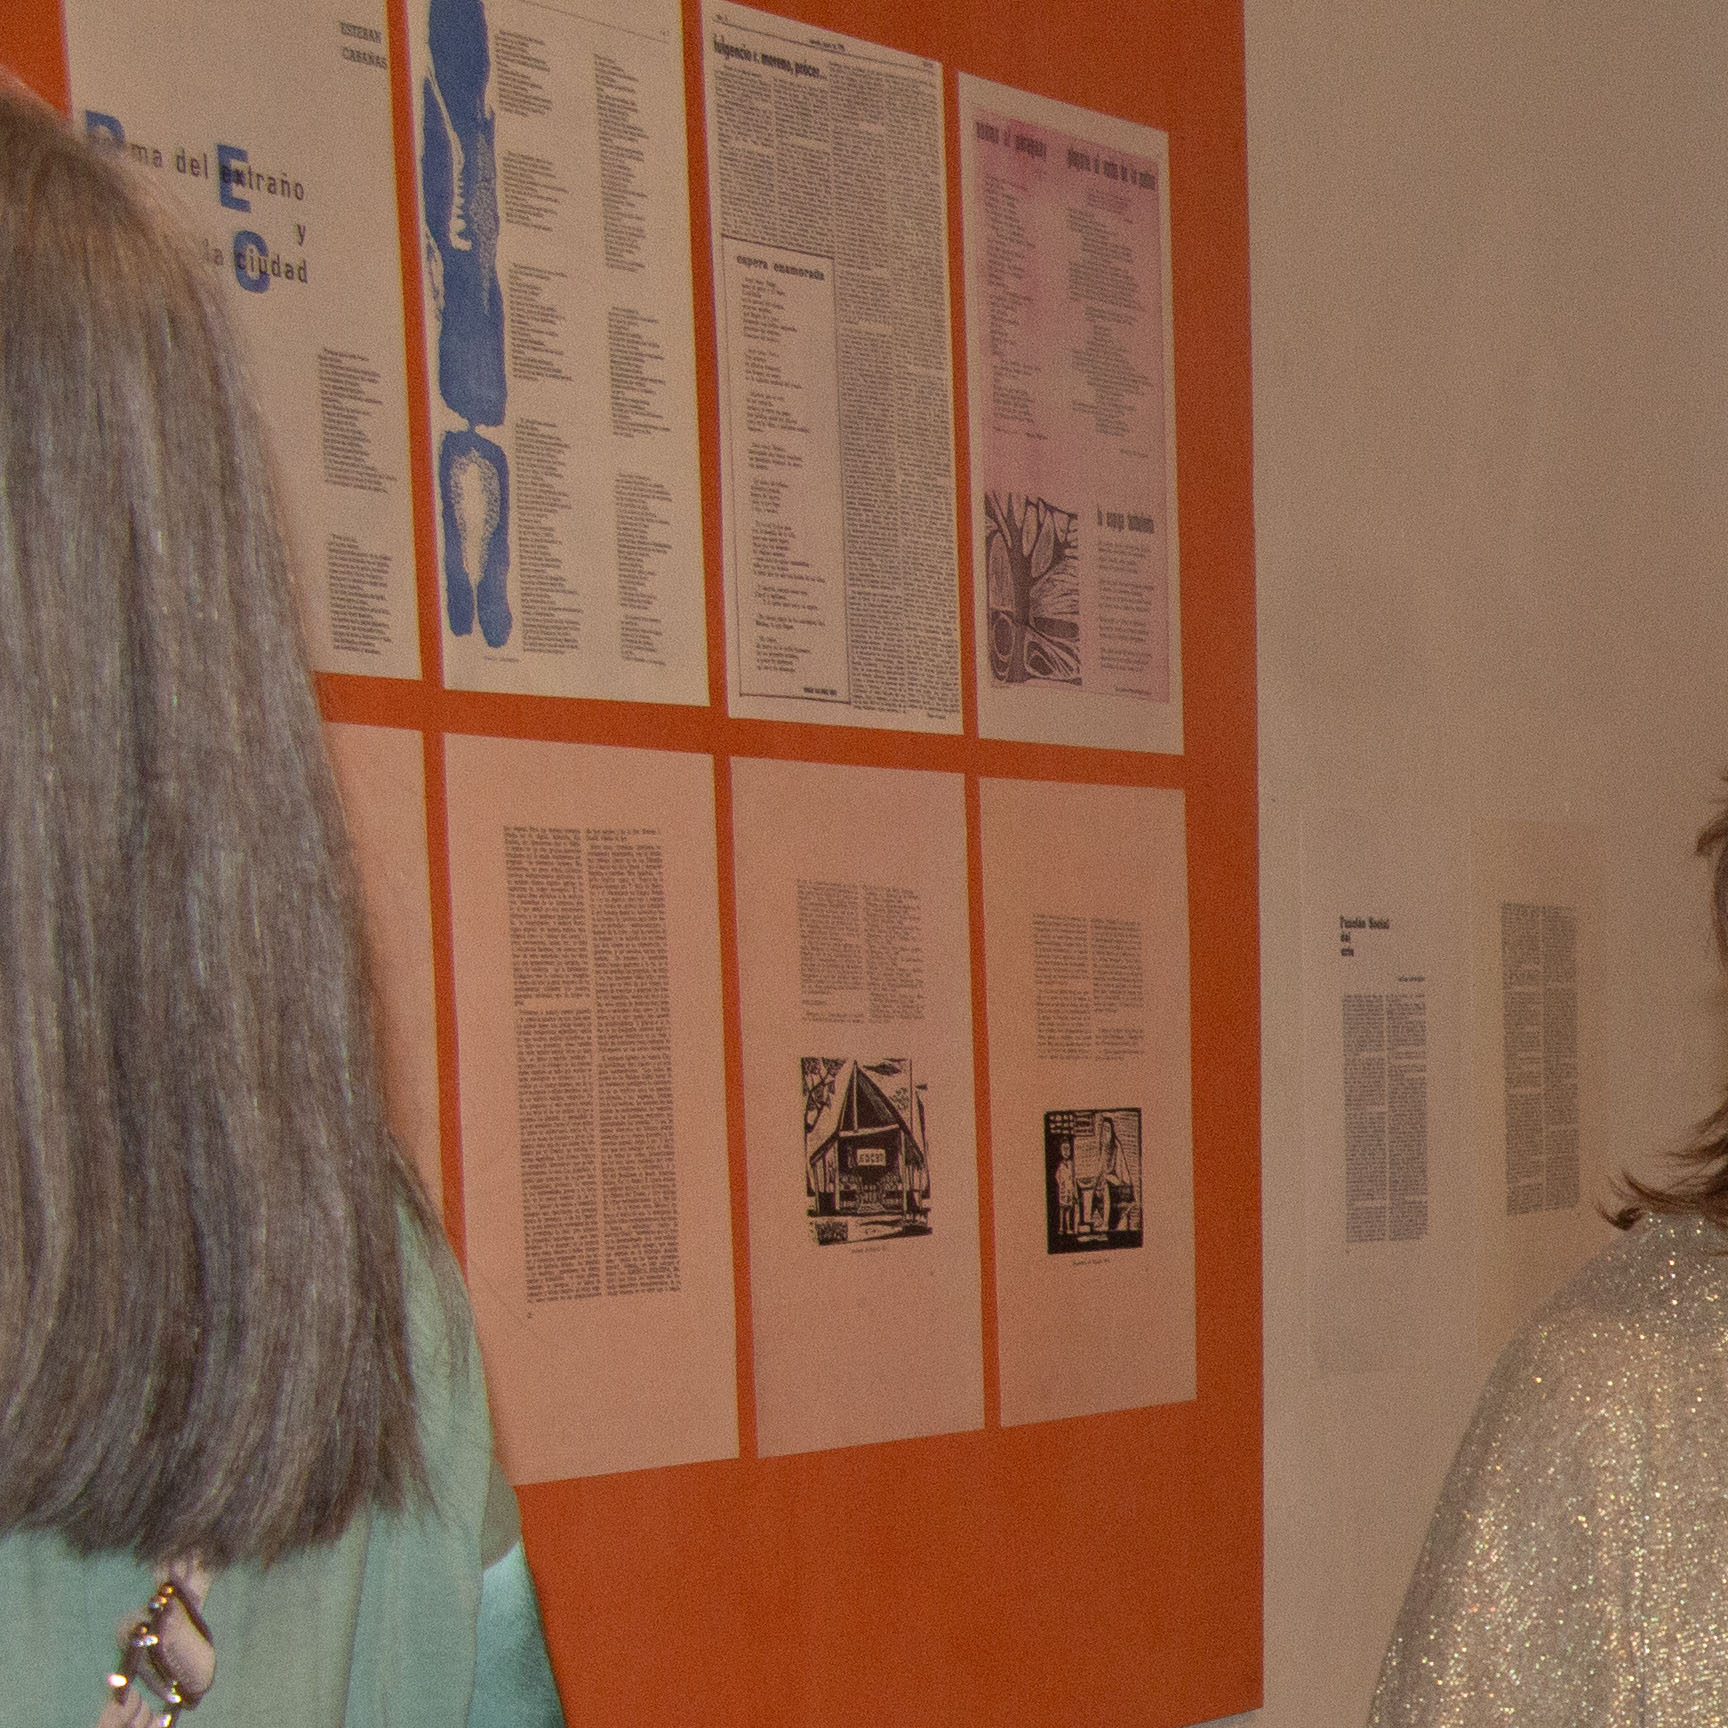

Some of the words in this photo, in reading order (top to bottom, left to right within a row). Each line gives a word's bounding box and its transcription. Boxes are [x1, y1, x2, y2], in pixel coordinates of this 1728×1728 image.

[176, 148, 210, 179] del
[296, 223, 306, 247] y
[236, 249, 308, 284] ciudad
